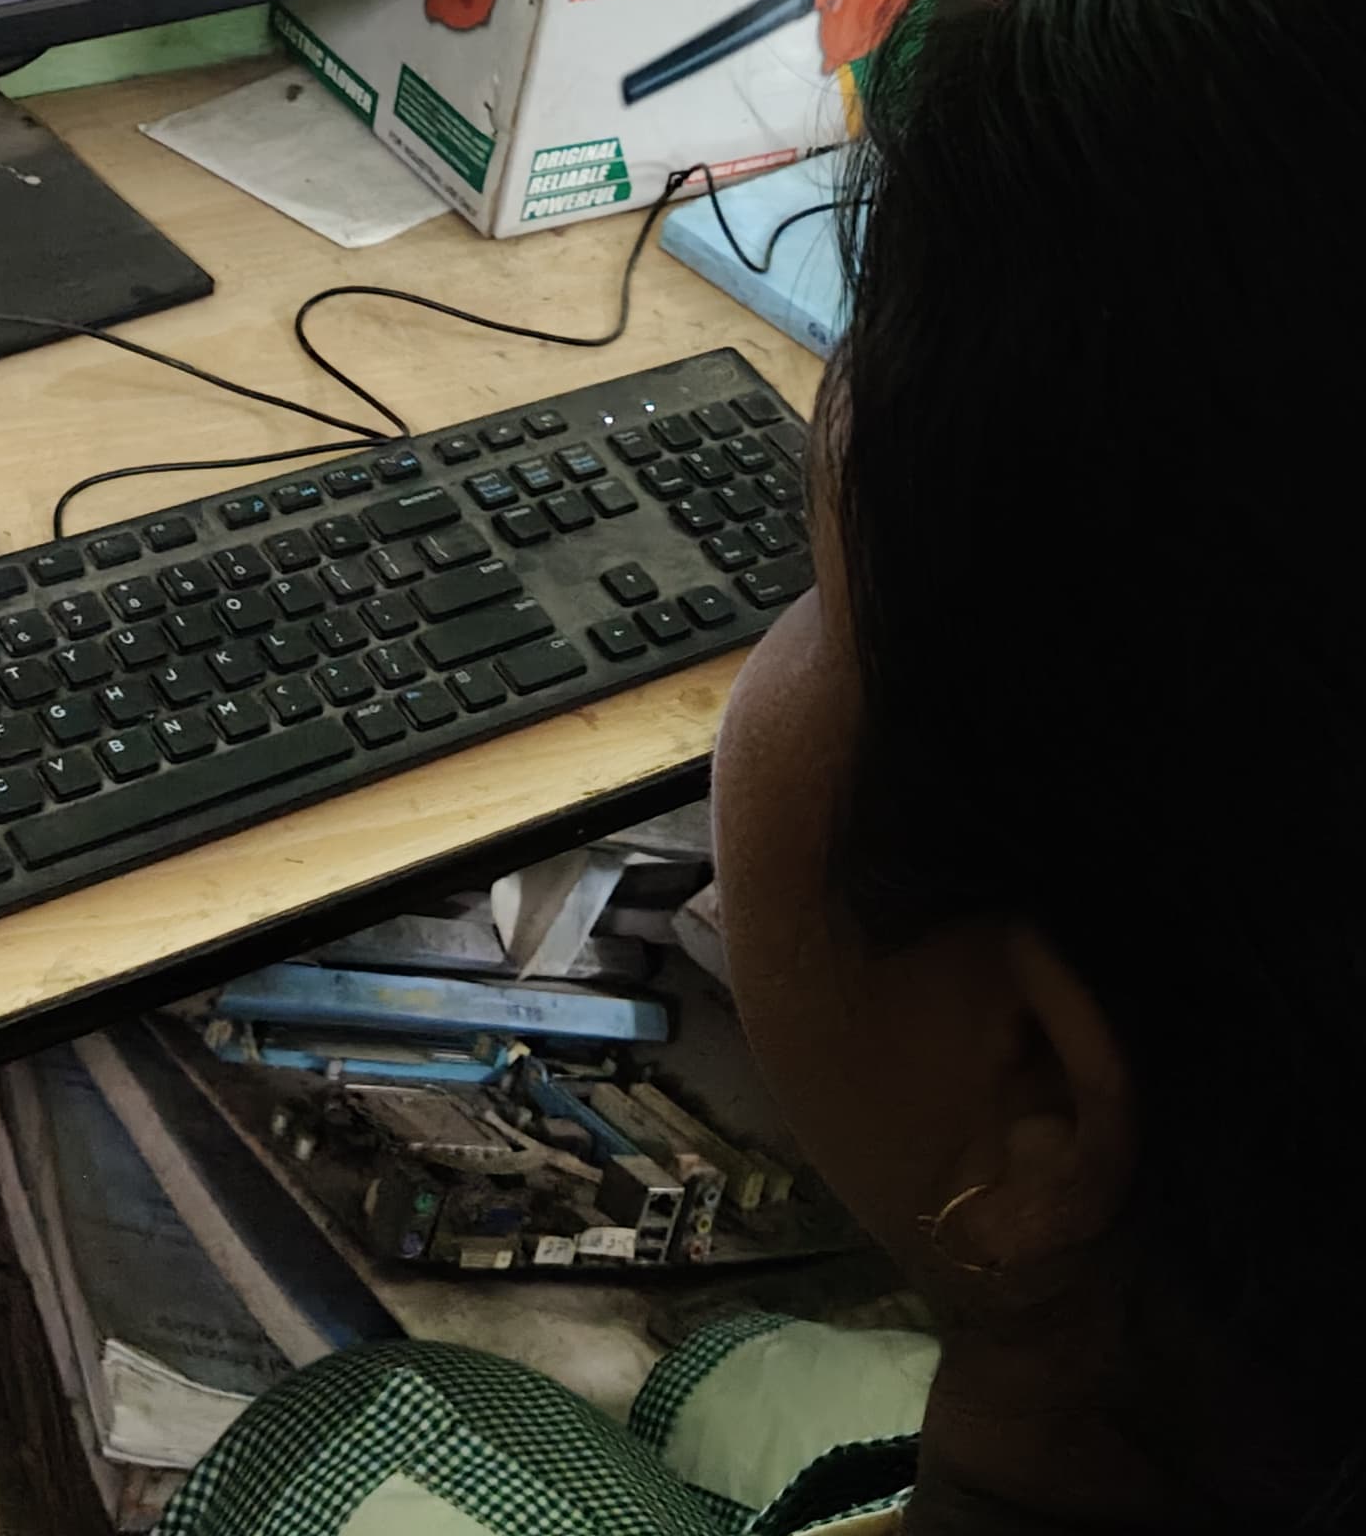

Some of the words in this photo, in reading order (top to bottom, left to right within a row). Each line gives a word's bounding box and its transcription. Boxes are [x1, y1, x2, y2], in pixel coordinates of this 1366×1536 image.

[534, 140, 618, 172] ORIGINAL
[528, 163, 611, 196] RELIABLE
[522, 184, 617, 219] POWERFUL
